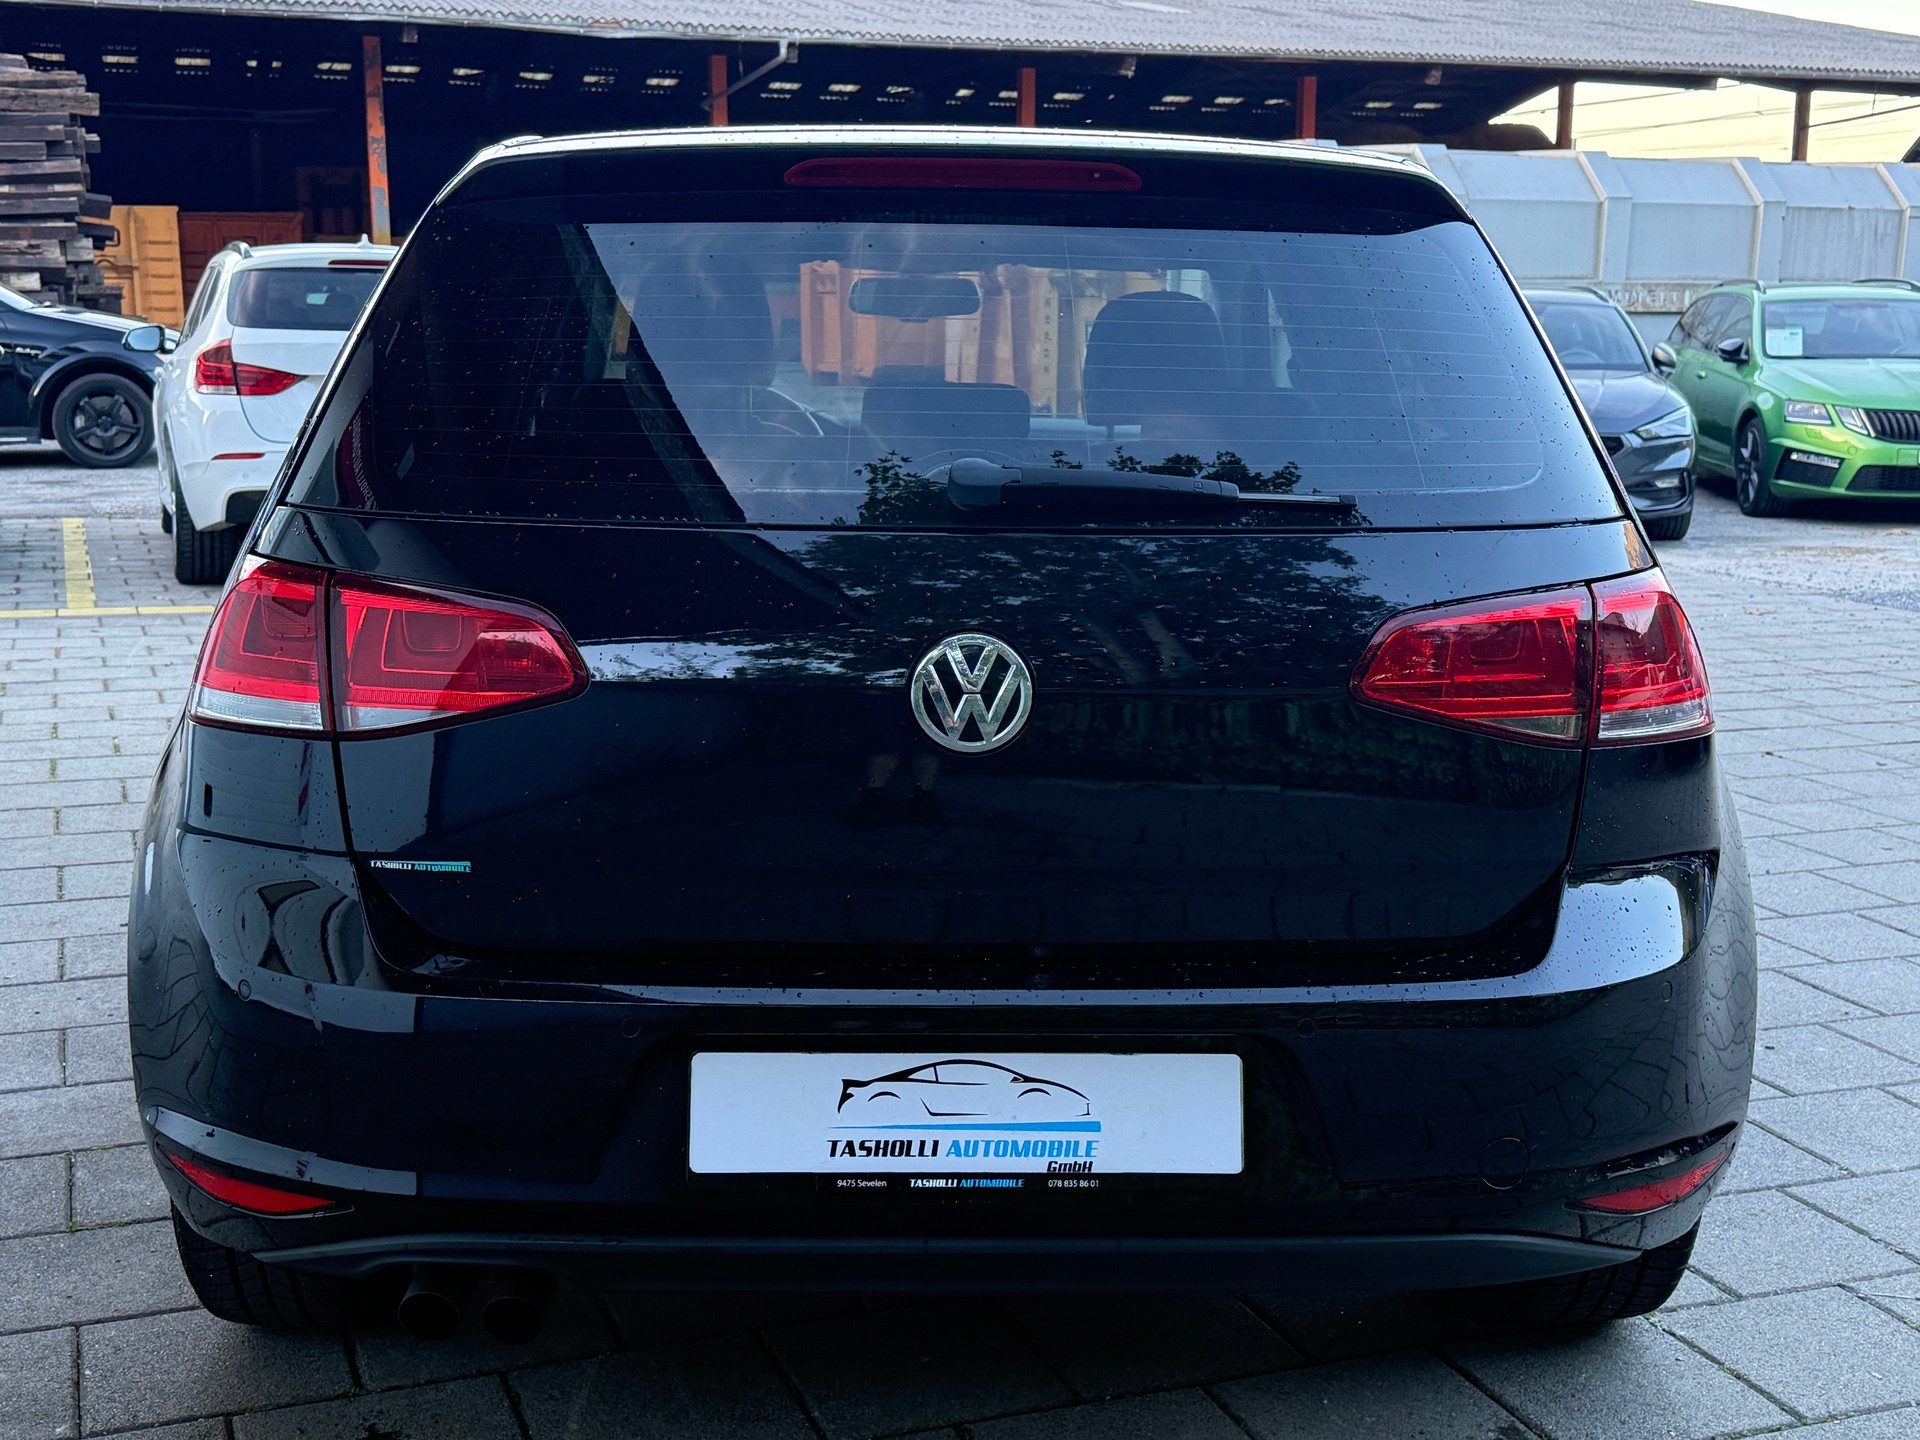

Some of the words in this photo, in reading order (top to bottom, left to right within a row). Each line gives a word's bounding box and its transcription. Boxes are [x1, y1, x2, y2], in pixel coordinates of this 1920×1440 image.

[369, 860, 412, 870] TASHOLLI
[826, 1139, 940, 1158] TASHOLLI
[945, 1139, 1100, 1158] AUTOMOBILE
[1046, 1160, 1094, 1173] GmbH
[836, 1179, 856, 1188] 9475
[857, 1179, 887, 1188] Sevelen
[909, 1178, 958, 1188] TASHOLLI
[959, 1178, 1025, 1188] AUTOMOBILE
[1047, 1179, 1063, 1188] 078
[1063, 1179, 1078, 1188] 835
[1079, 1179, 1089, 1188] 86
[1090, 1179, 1100, 1188] 01
